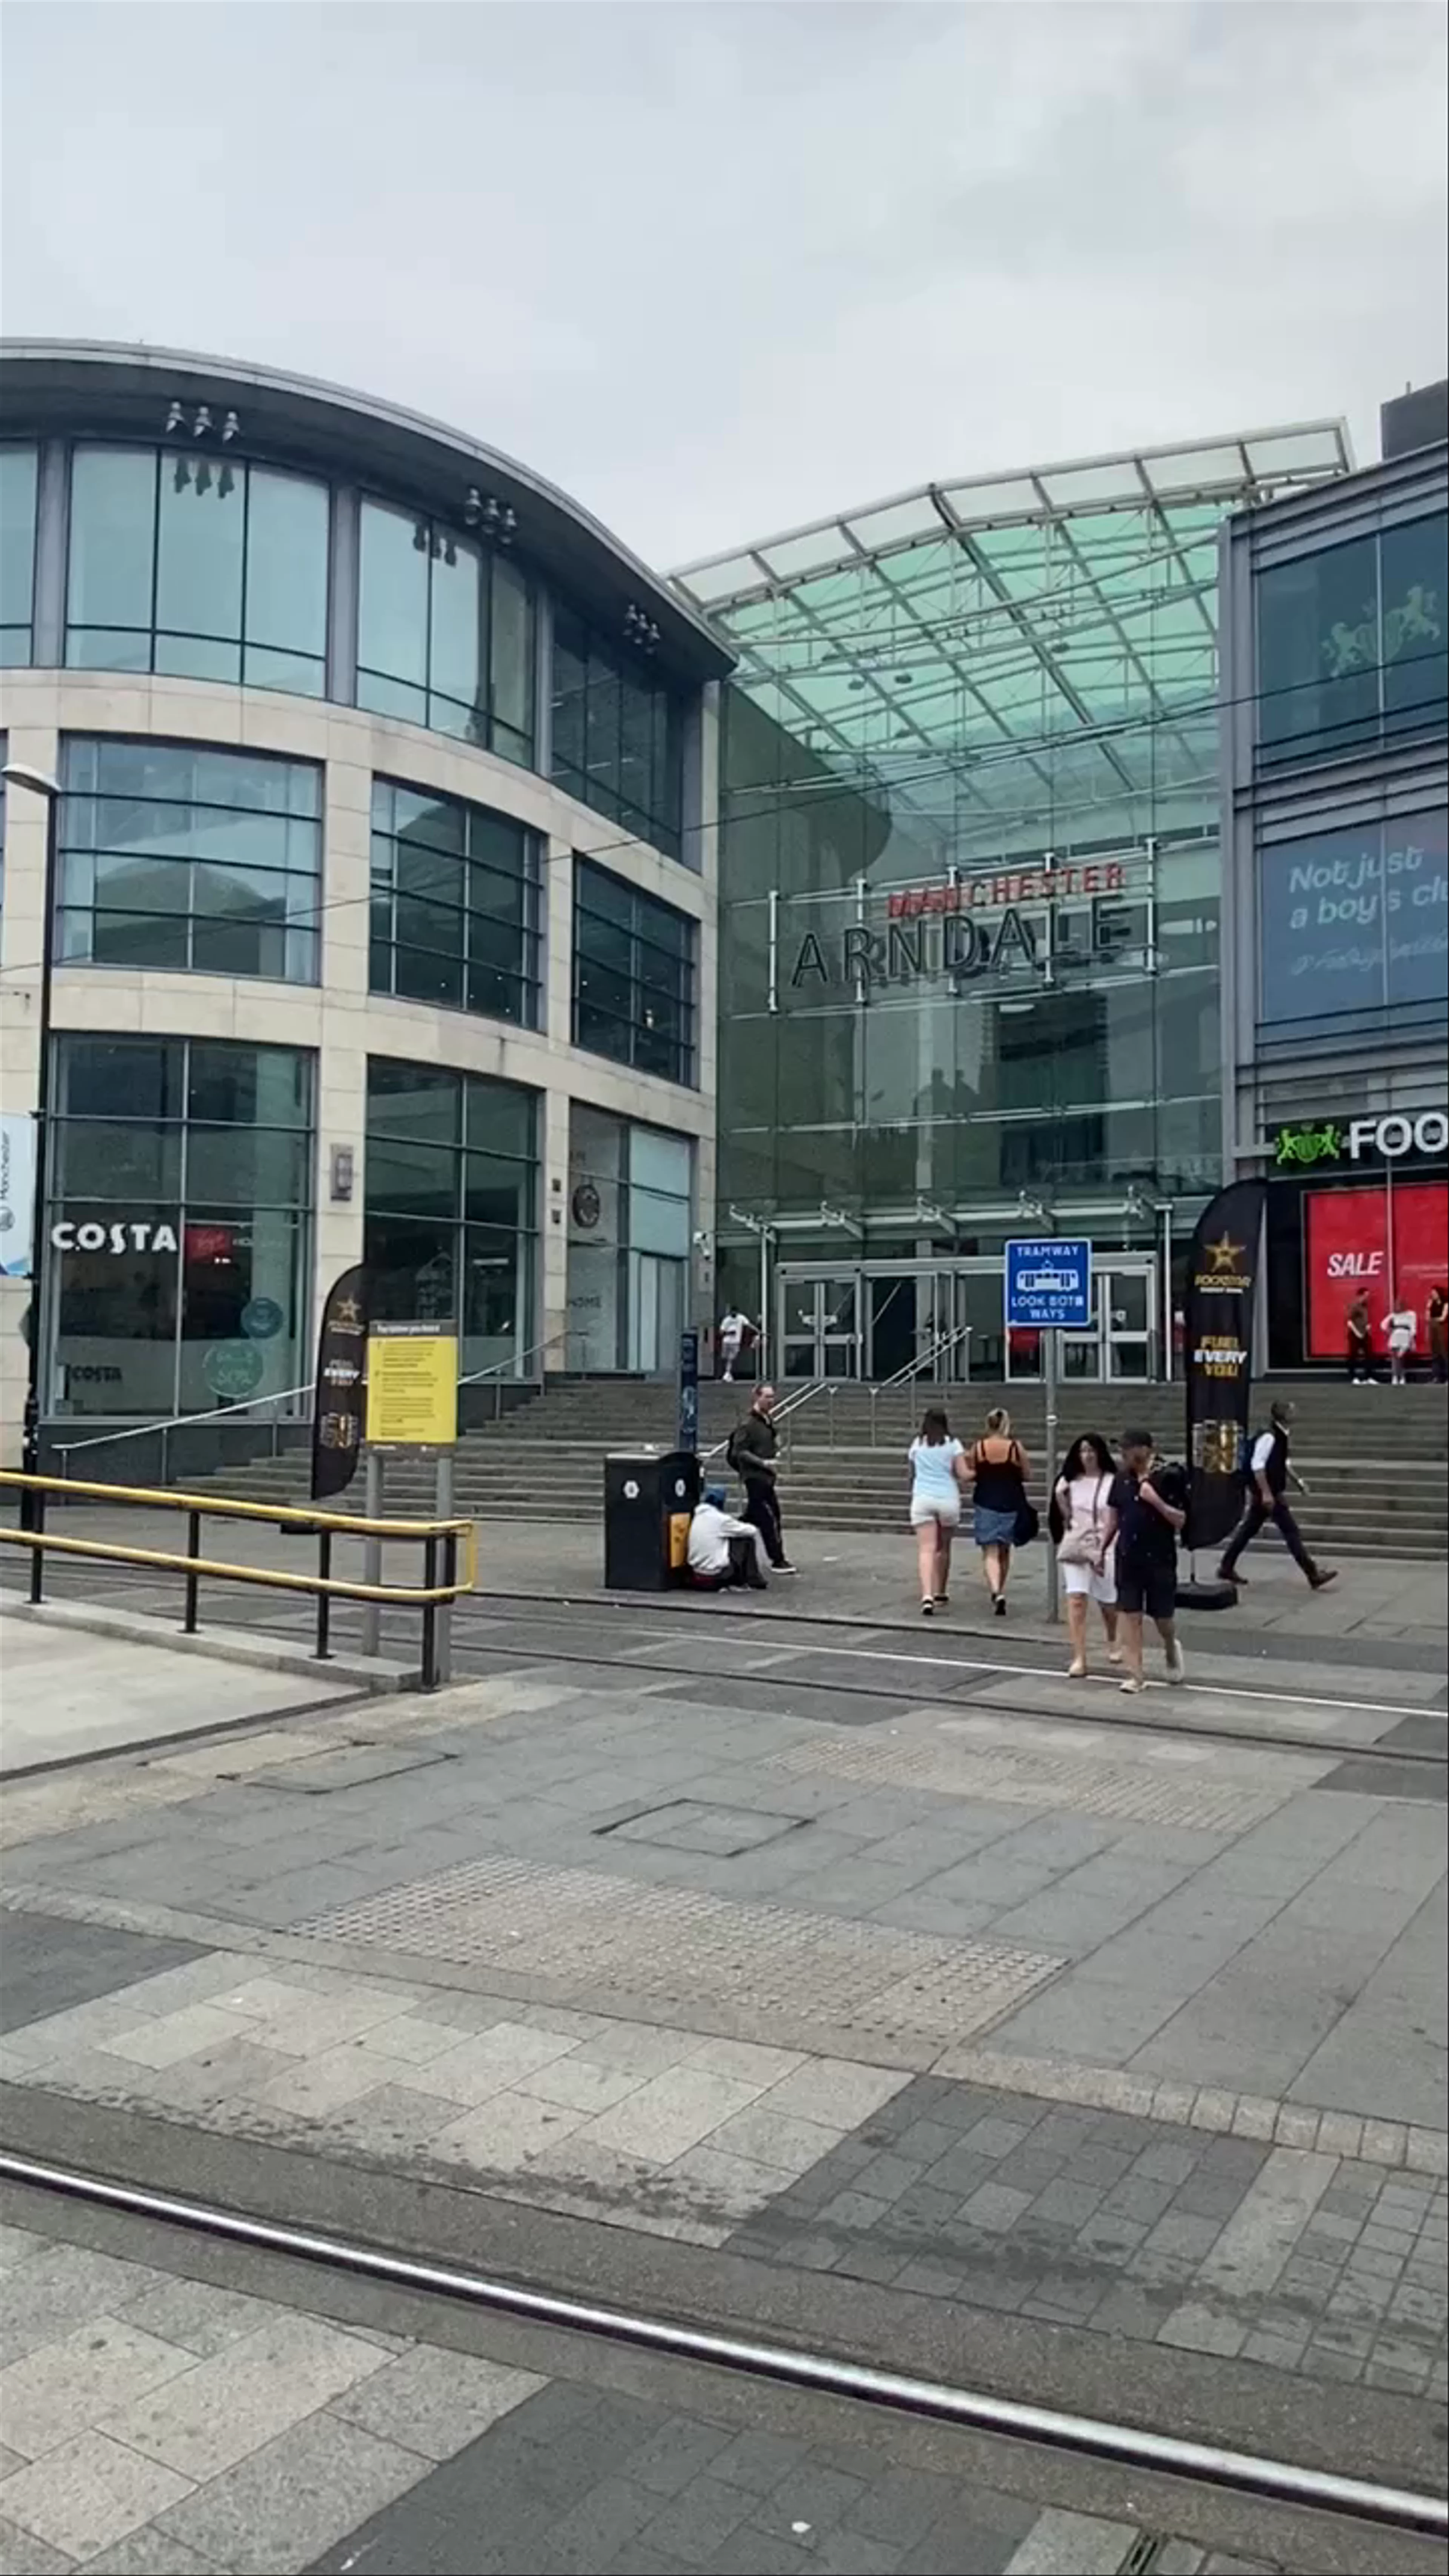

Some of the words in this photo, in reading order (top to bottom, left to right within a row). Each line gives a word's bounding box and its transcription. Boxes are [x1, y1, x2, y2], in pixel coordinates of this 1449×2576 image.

[1289, 860, 1351, 893] Not
[1347, 845, 1424, 890] just
[888, 863, 1125, 917] MANCHESTER
[1290, 908, 1308, 929] a
[791, 894, 1124, 988] ARNDALE
[51, 1222, 178, 1254] COSTA
[1017, 1246, 1078, 1257] TRAMWAY
[1327, 1252, 1383, 1277] SALE
[1011, 1295, 1046, 1307] LOOK
[1049, 1295, 1084, 1307] BOTH
[1030, 1308, 1066, 1320] WAYS
[1201, 1336, 1239, 1349] FUEL
[1194, 1350, 1247, 1364] EVERY
[72, 1365, 123, 1383] COSTA
[1204, 1363, 1238, 1377] YOU
